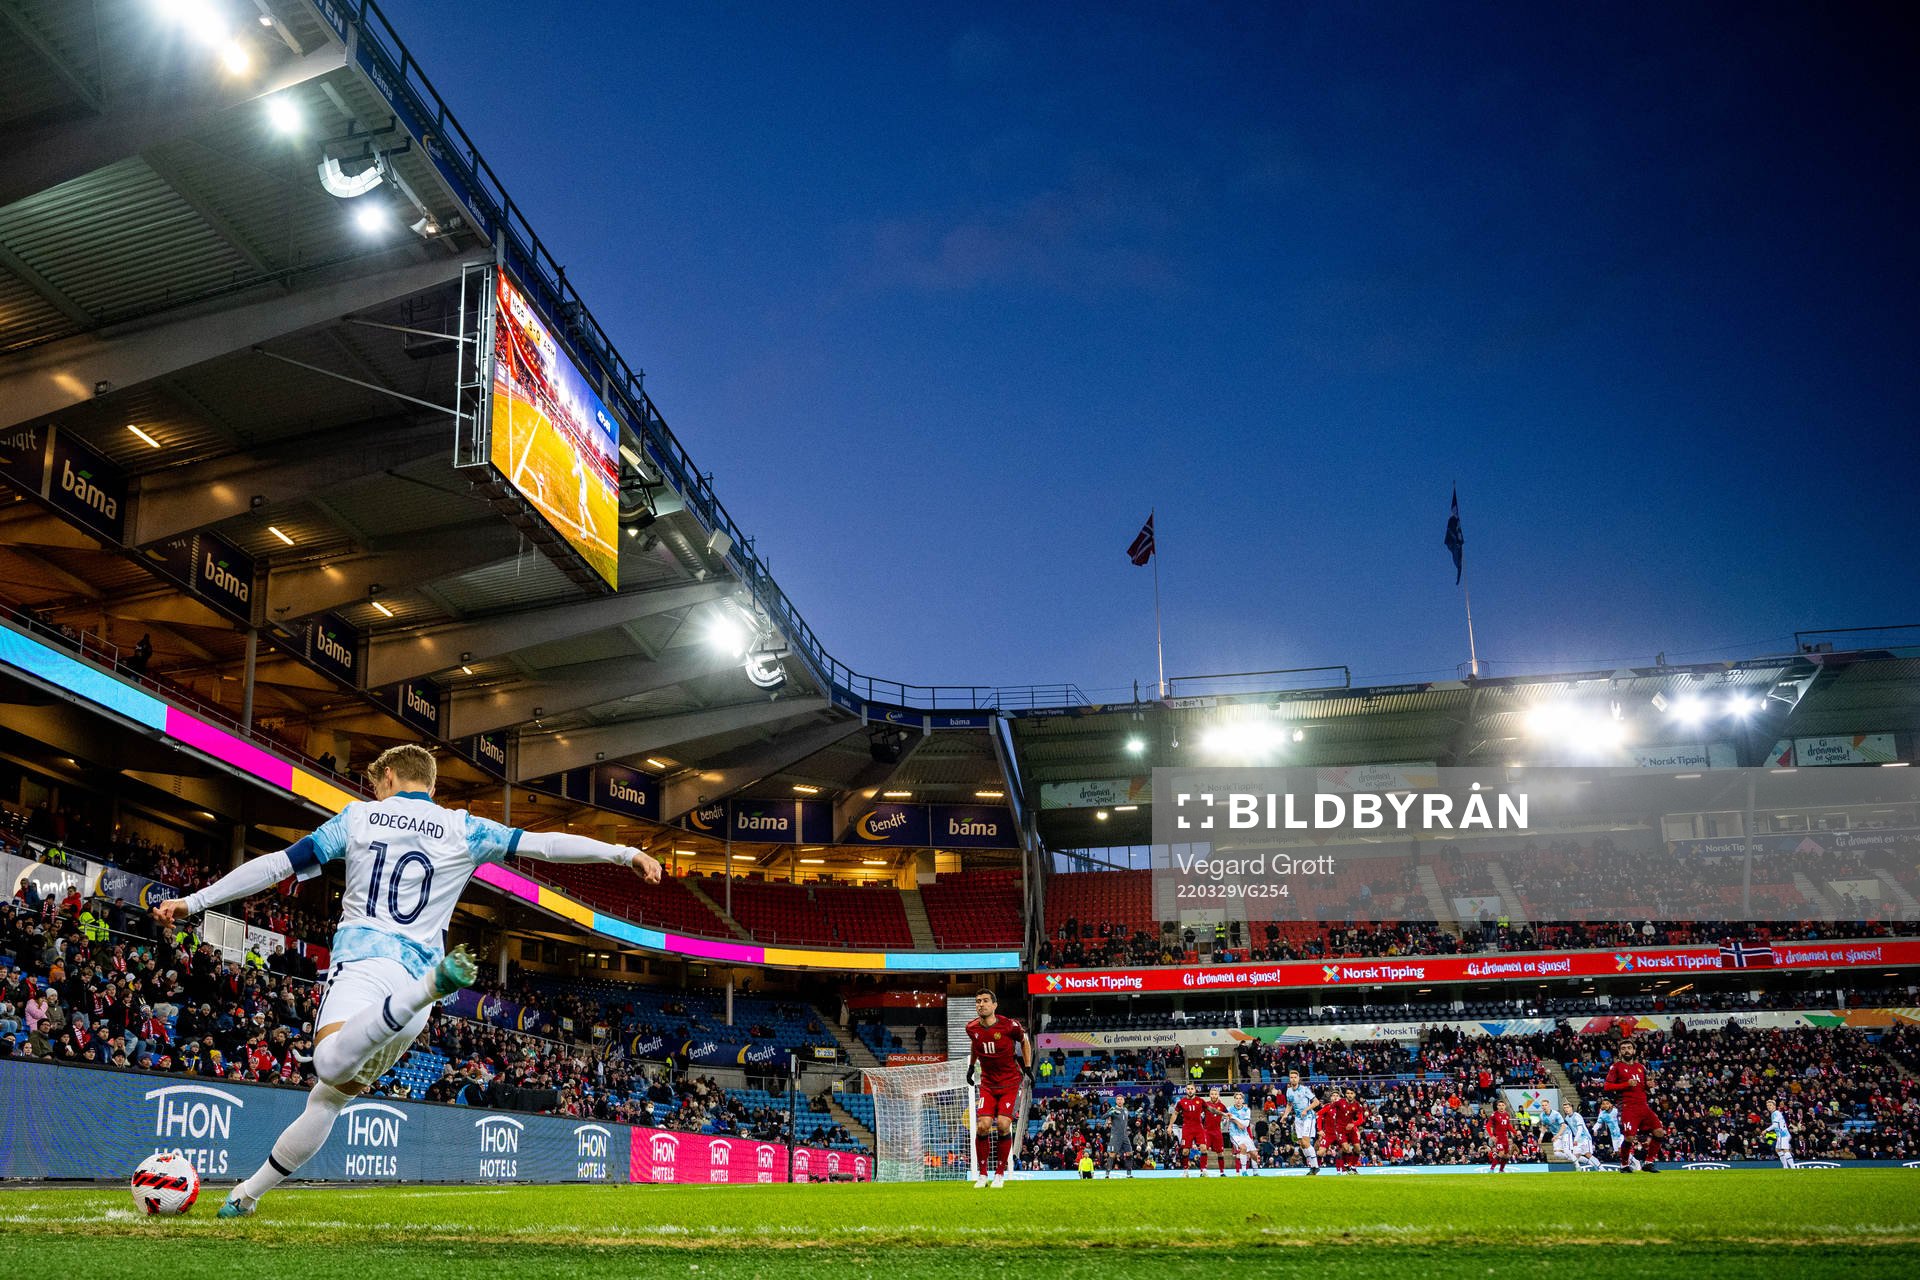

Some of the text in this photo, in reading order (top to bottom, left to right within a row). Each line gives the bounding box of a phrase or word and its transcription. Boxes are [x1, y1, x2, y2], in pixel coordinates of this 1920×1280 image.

[61, 459, 117, 520] bama
[204, 552, 249, 603] bama
[317, 626, 352, 669] bama
[407, 684, 436, 721] bama
[480, 734, 504, 765] bama
[1650, 758, 1676, 766] Norsk
[609, 778, 645, 806] bama
[369, 812, 444, 839] ØDEGAARD
[737, 812, 788, 830] bama
[869, 811, 907, 833] Bendit
[949, 817, 997, 836] bama
[1705, 843, 1763, 855] Norsk Tipng
[103, 875, 128, 891] Bendit
[366, 840, 434, 925] 10
[1637, 953, 1721, 968] Norsk Tipping
[1785, 949, 1829, 964] drømmen
[1830, 950, 1843, 960] en
[1845, 946, 1882, 963] sjanse!
[1343, 965, 1425, 980] Norsk Tipping
[1468, 959, 1571, 976] Gi drømmen en sjanse!
[1065, 975, 1142, 990] Norsk Tipping
[1183, 969, 1281, 986] Gi drømmen en sjanse!
[1104, 1031, 1176, 1045] Gi drømmen en sjanse!
[1383, 1027, 1407, 1036] Norsk
[638, 1035, 663, 1055] Bendit
[688, 1040, 715, 1060] Bendit
[747, 1045, 776, 1062] Bendit
[983, 1041, 996, 1054] 10
[147, 1086, 242, 1139] THON
[341, 1103, 407, 1147] THON
[476, 1116, 524, 1153] THON
[574, 1125, 611, 1157] THON
[650, 1134, 679, 1162] THON
[154, 1148, 228, 1174] TELS
[709, 1140, 731, 1165] THON
[346, 1154, 397, 1176] HOTELS
[479, 1159, 517, 1177] HOTELS
[577, 1162, 606, 1178] HOTELS
[652, 1166, 675, 1181] HOTELS
[710, 1169, 729, 1182] HOTELS
